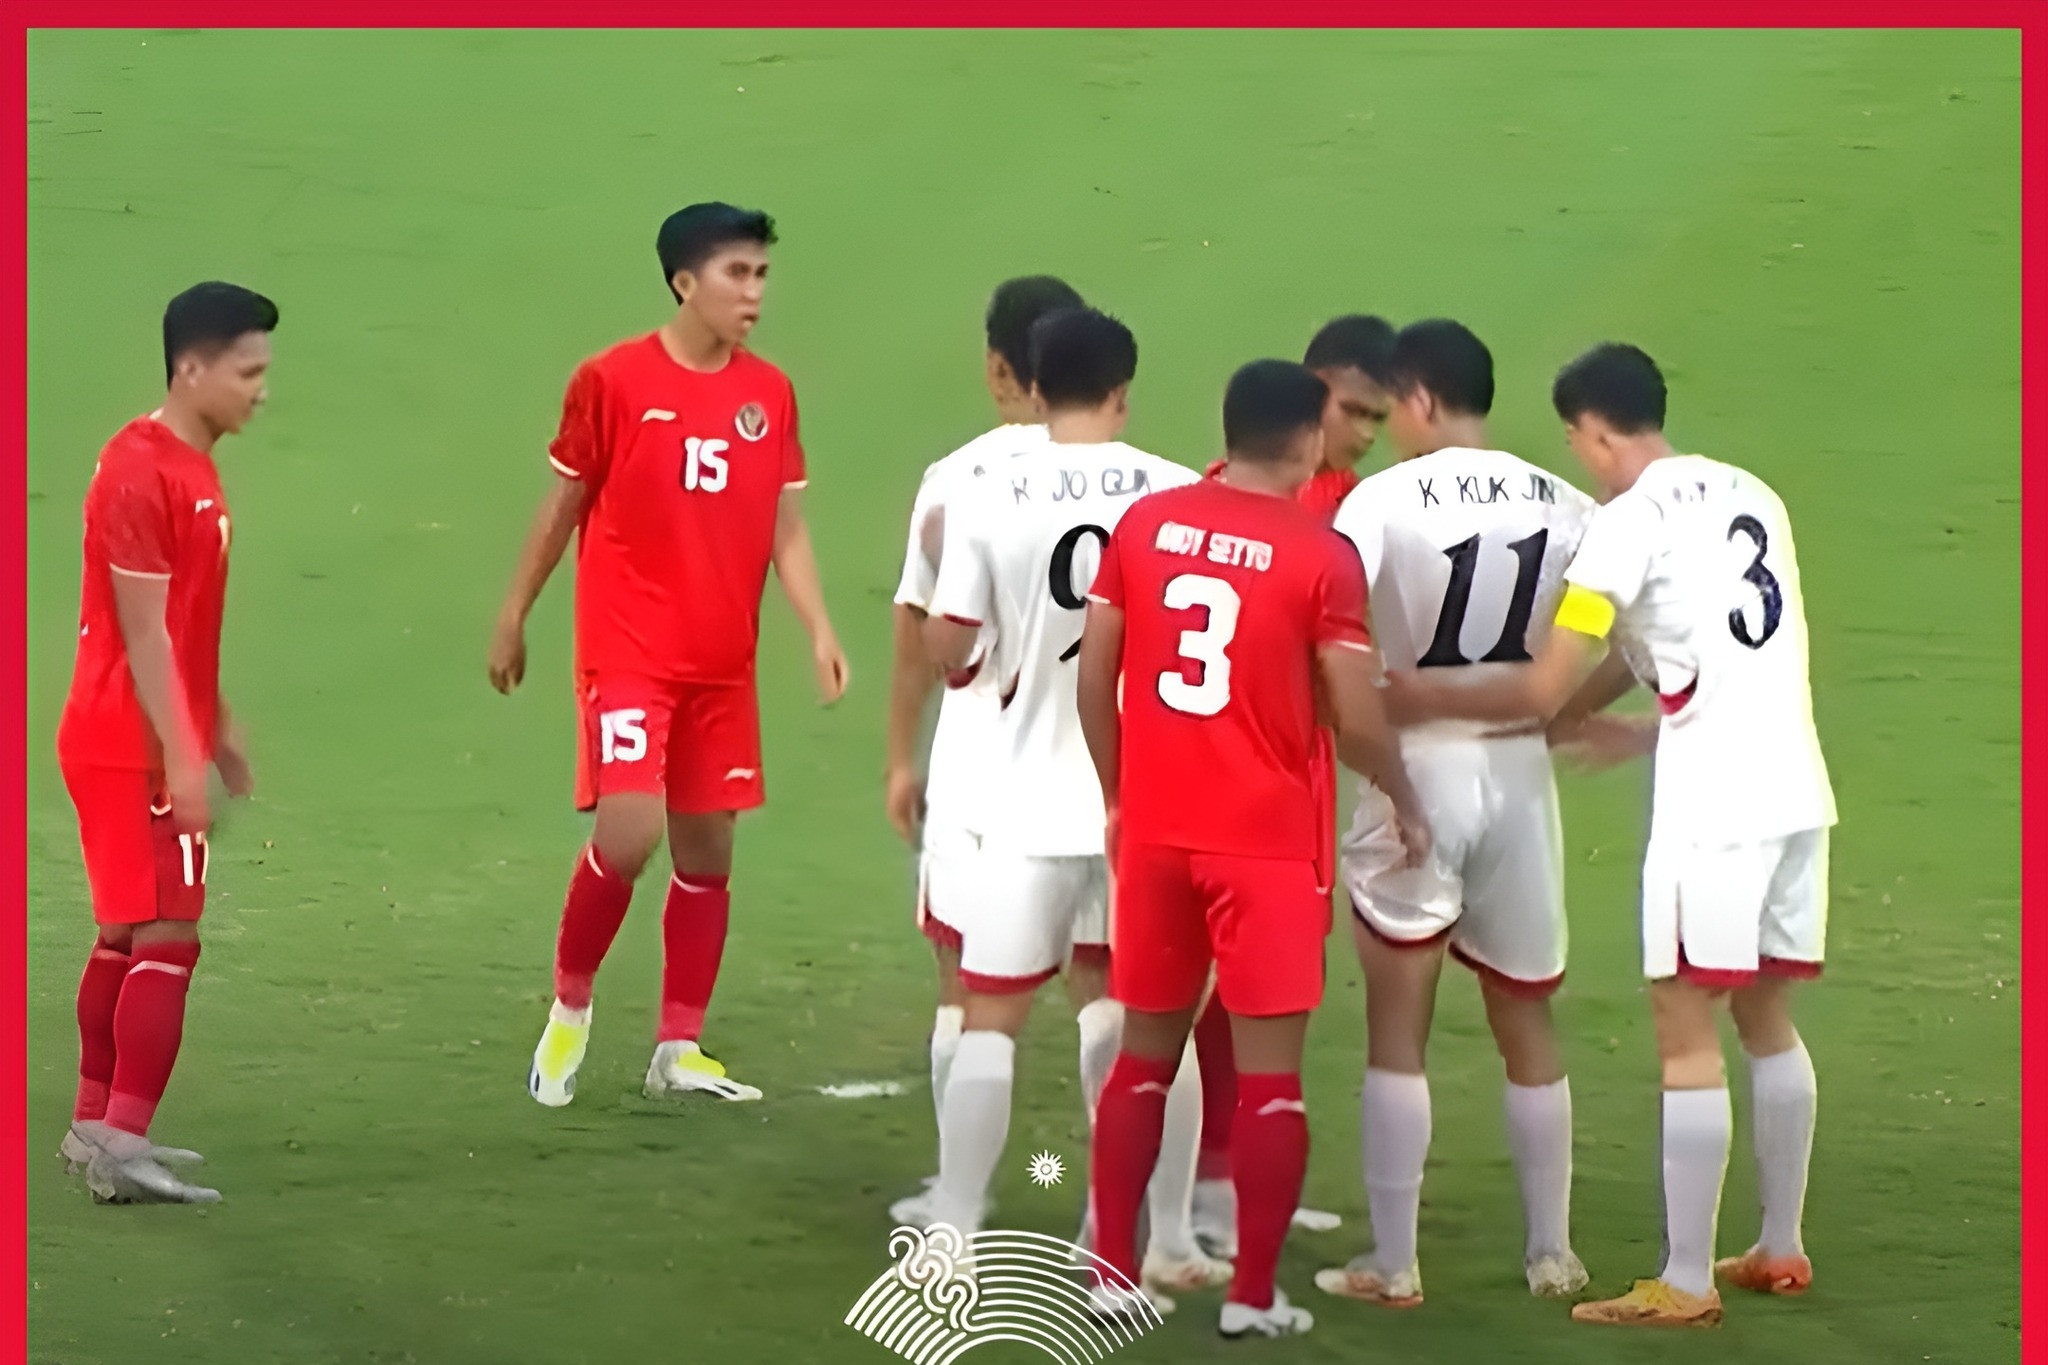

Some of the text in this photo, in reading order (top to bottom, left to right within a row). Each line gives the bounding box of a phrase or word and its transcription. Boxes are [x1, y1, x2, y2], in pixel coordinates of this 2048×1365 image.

[684, 436, 730, 493] 15
[1418, 477, 1440, 508] K
[1456, 475, 1510, 503] KUK
[1416, 527, 1549, 668] 11
[1726, 513, 1783, 650] 3
[1160, 573, 1242, 716] 3
[600, 708, 648, 764] 15
